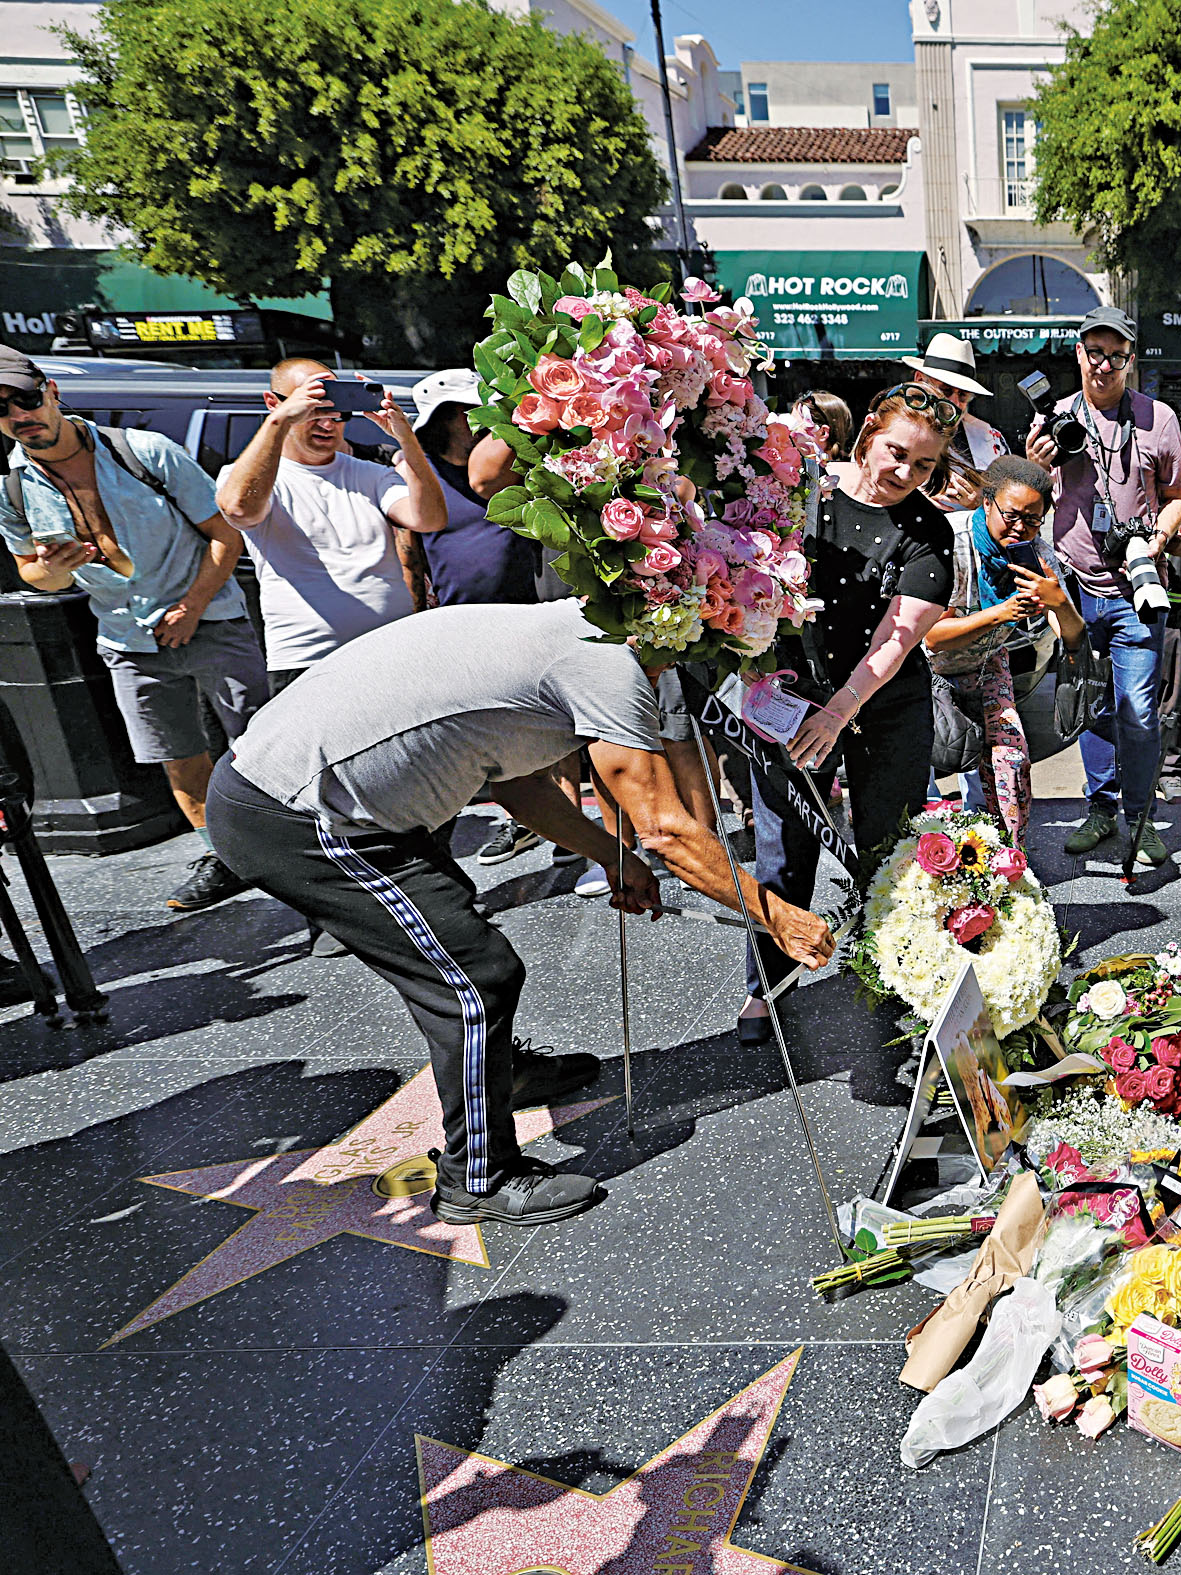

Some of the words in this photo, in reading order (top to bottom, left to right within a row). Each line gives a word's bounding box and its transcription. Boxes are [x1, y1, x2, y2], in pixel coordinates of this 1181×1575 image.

[768, 277, 815, 295] HOT
[820, 277, 886, 296] ROCK
[773, 313, 795, 325] 323
[797, 314, 819, 325] 462
[820, 314, 848, 325] 3348
[135, 321, 184, 336] RENT
[187, 320, 216, 336] ME
[880, 332, 900, 341] 6717
[960, 329, 980, 339] THE
[983, 328, 1035, 339] OUTPOST
[1039, 329, 1081, 339] BUILDIN
[1145, 348, 1162, 356] 6711
[701, 695, 772, 776] DOLLY
[787, 779, 848, 864] PARTON
[266, 1138, 377, 1218] DOUGLAS
[275, 1146, 398, 1241] FAIRBANKS
[1130, 1353, 1168, 1384] Dolly
